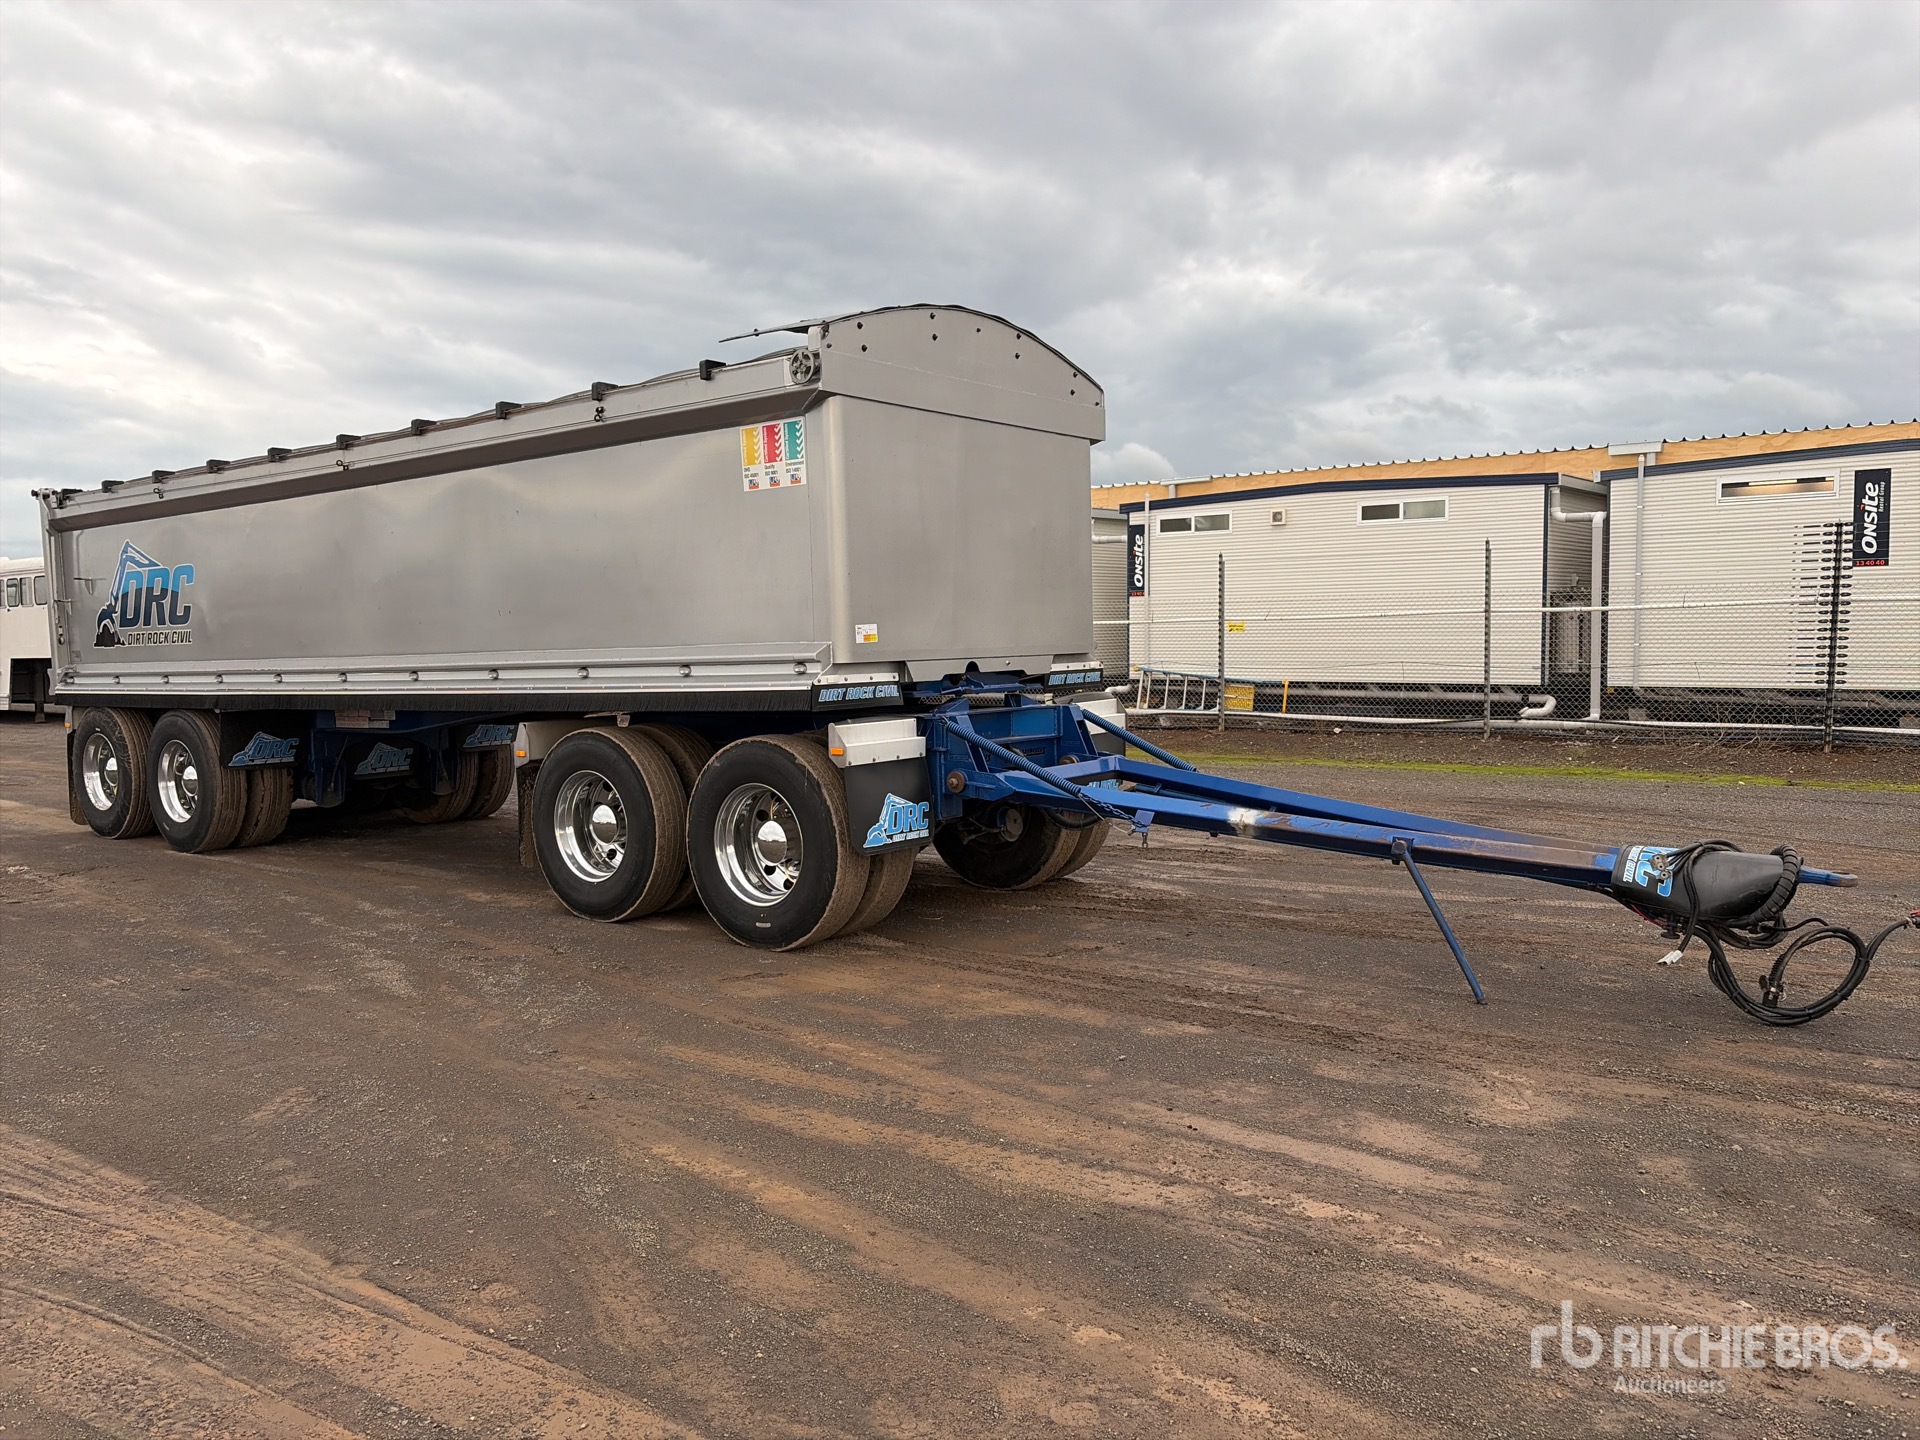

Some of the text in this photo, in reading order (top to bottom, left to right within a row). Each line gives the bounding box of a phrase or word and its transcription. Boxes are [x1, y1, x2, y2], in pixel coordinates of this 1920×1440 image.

[119, 564, 195, 630] DRC
[127, 629, 192, 646] DIRT ROCK CIVIL
[818, 684, 900, 702] DIRT ROCK CIVIL
[248, 738, 300, 759] DRC
[371, 748, 414, 768] DRC
[886, 802, 930, 835] DRC
[1623, 860, 1636, 882] CIVIL
